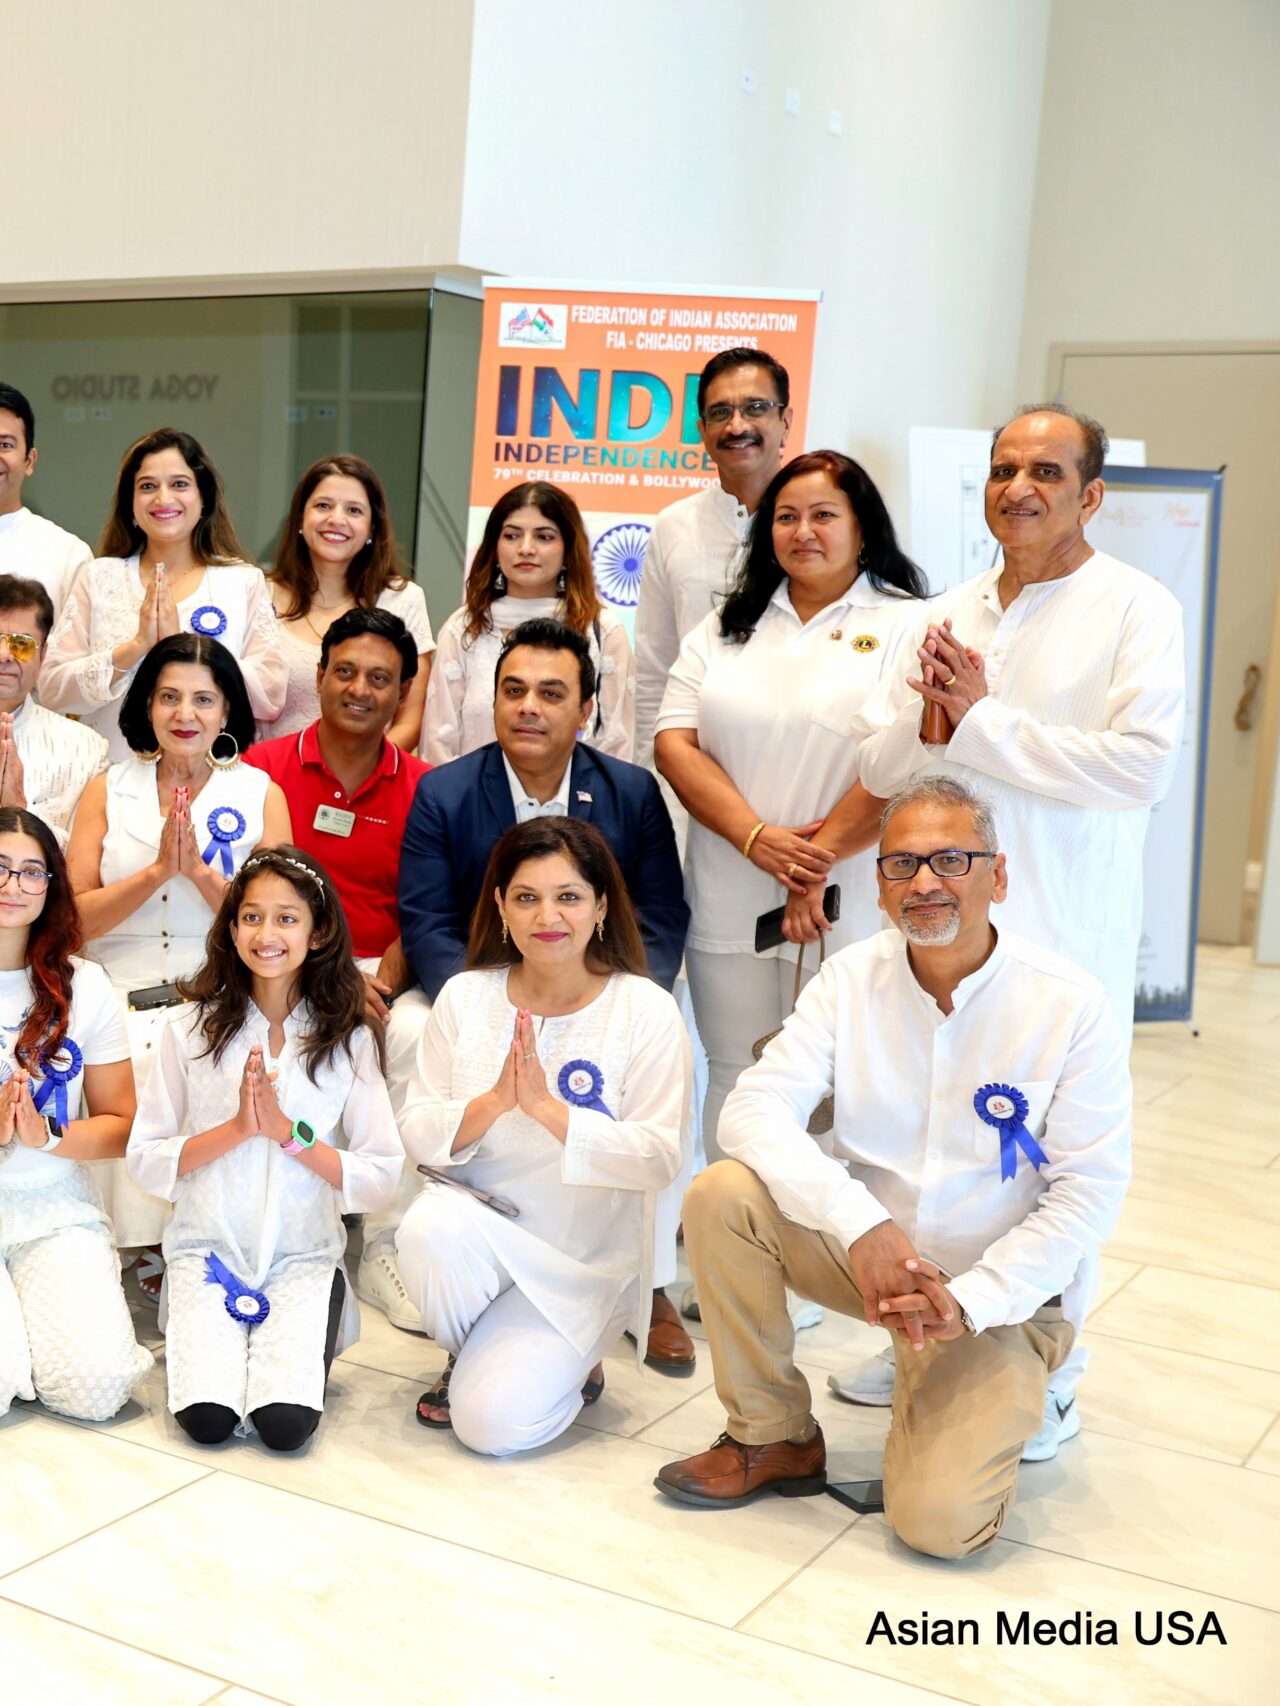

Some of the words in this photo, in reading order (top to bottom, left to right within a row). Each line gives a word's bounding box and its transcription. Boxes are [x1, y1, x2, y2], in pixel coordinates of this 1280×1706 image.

[572, 305, 647, 325] FEDERATION
[650, 310, 666, 326] OF
[670, 311, 712, 328] INDIAN
[715, 312, 797, 332] ASSOCIATION
[606, 331, 626, 348] FIA
[636, 332, 691, 351] CHICAGO
[695, 334, 758, 353] PRESENTS
[495, 365, 703, 445] INDI
[494, 442, 718, 472] INDEPENDENCE
[527, 469, 624, 485] CELEBRATION
[629, 474, 638, 486] &
[643, 474, 721, 489] BOLLYWOO
